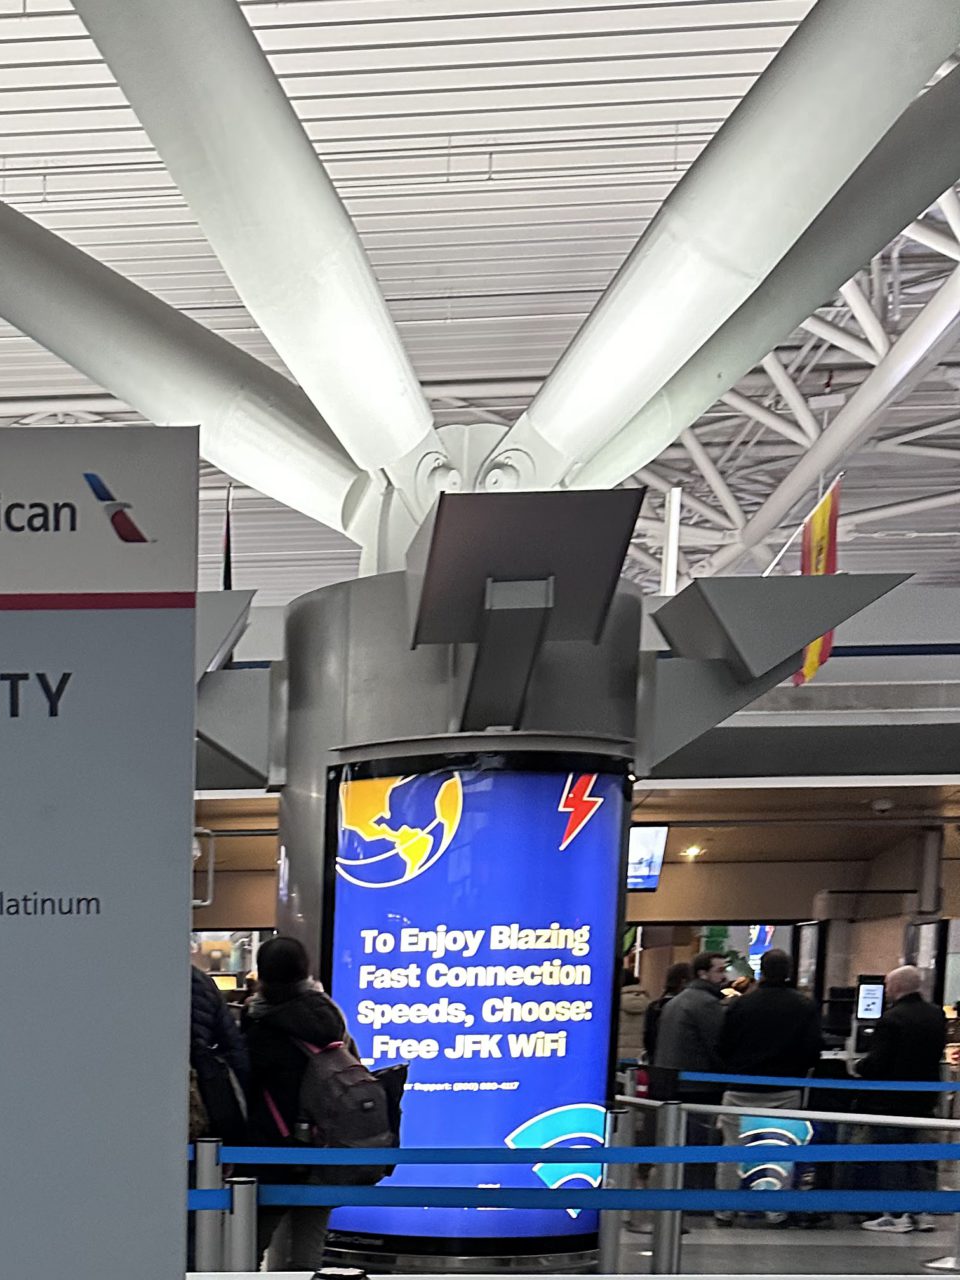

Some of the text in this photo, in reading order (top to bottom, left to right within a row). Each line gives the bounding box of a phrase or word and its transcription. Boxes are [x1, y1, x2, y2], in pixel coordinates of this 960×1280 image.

[360, 923, 590, 958] To Enjoy Blazing
[359, 960, 591, 989] Fast Connection
[357, 997, 592, 1029] Speeds, Choose:
[444, 1034, 502, 1059] JFK
[508, 1031, 567, 1058] WiFi
